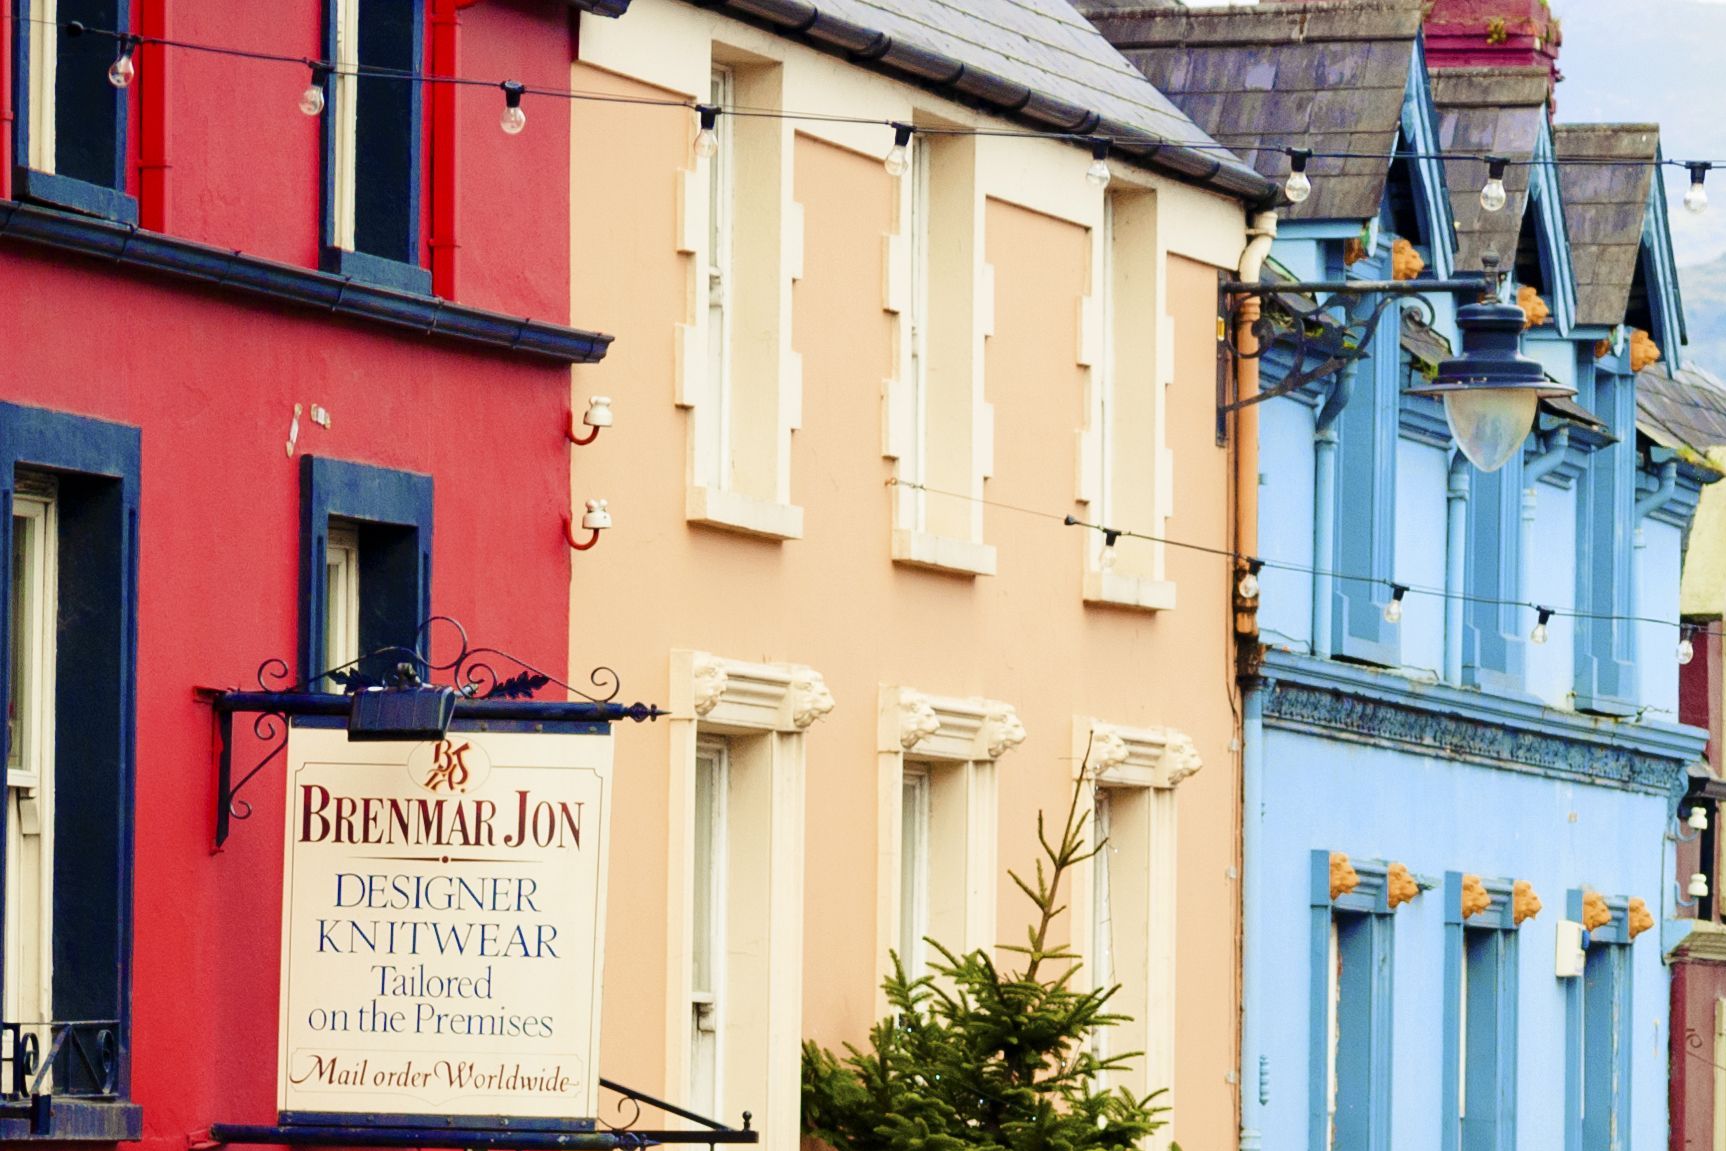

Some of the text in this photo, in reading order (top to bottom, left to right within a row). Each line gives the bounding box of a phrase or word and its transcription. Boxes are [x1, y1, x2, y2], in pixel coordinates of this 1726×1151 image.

[298, 784, 584, 851] BRENMAR JON
[334, 873, 542, 912] DESIGNER
[316, 919, 561, 959] KNITWEAR
[370, 964, 493, 999] Tailored
[308, 999, 553, 1038] on the Premises
[289, 1054, 580, 1093] Mail order Worldwide
